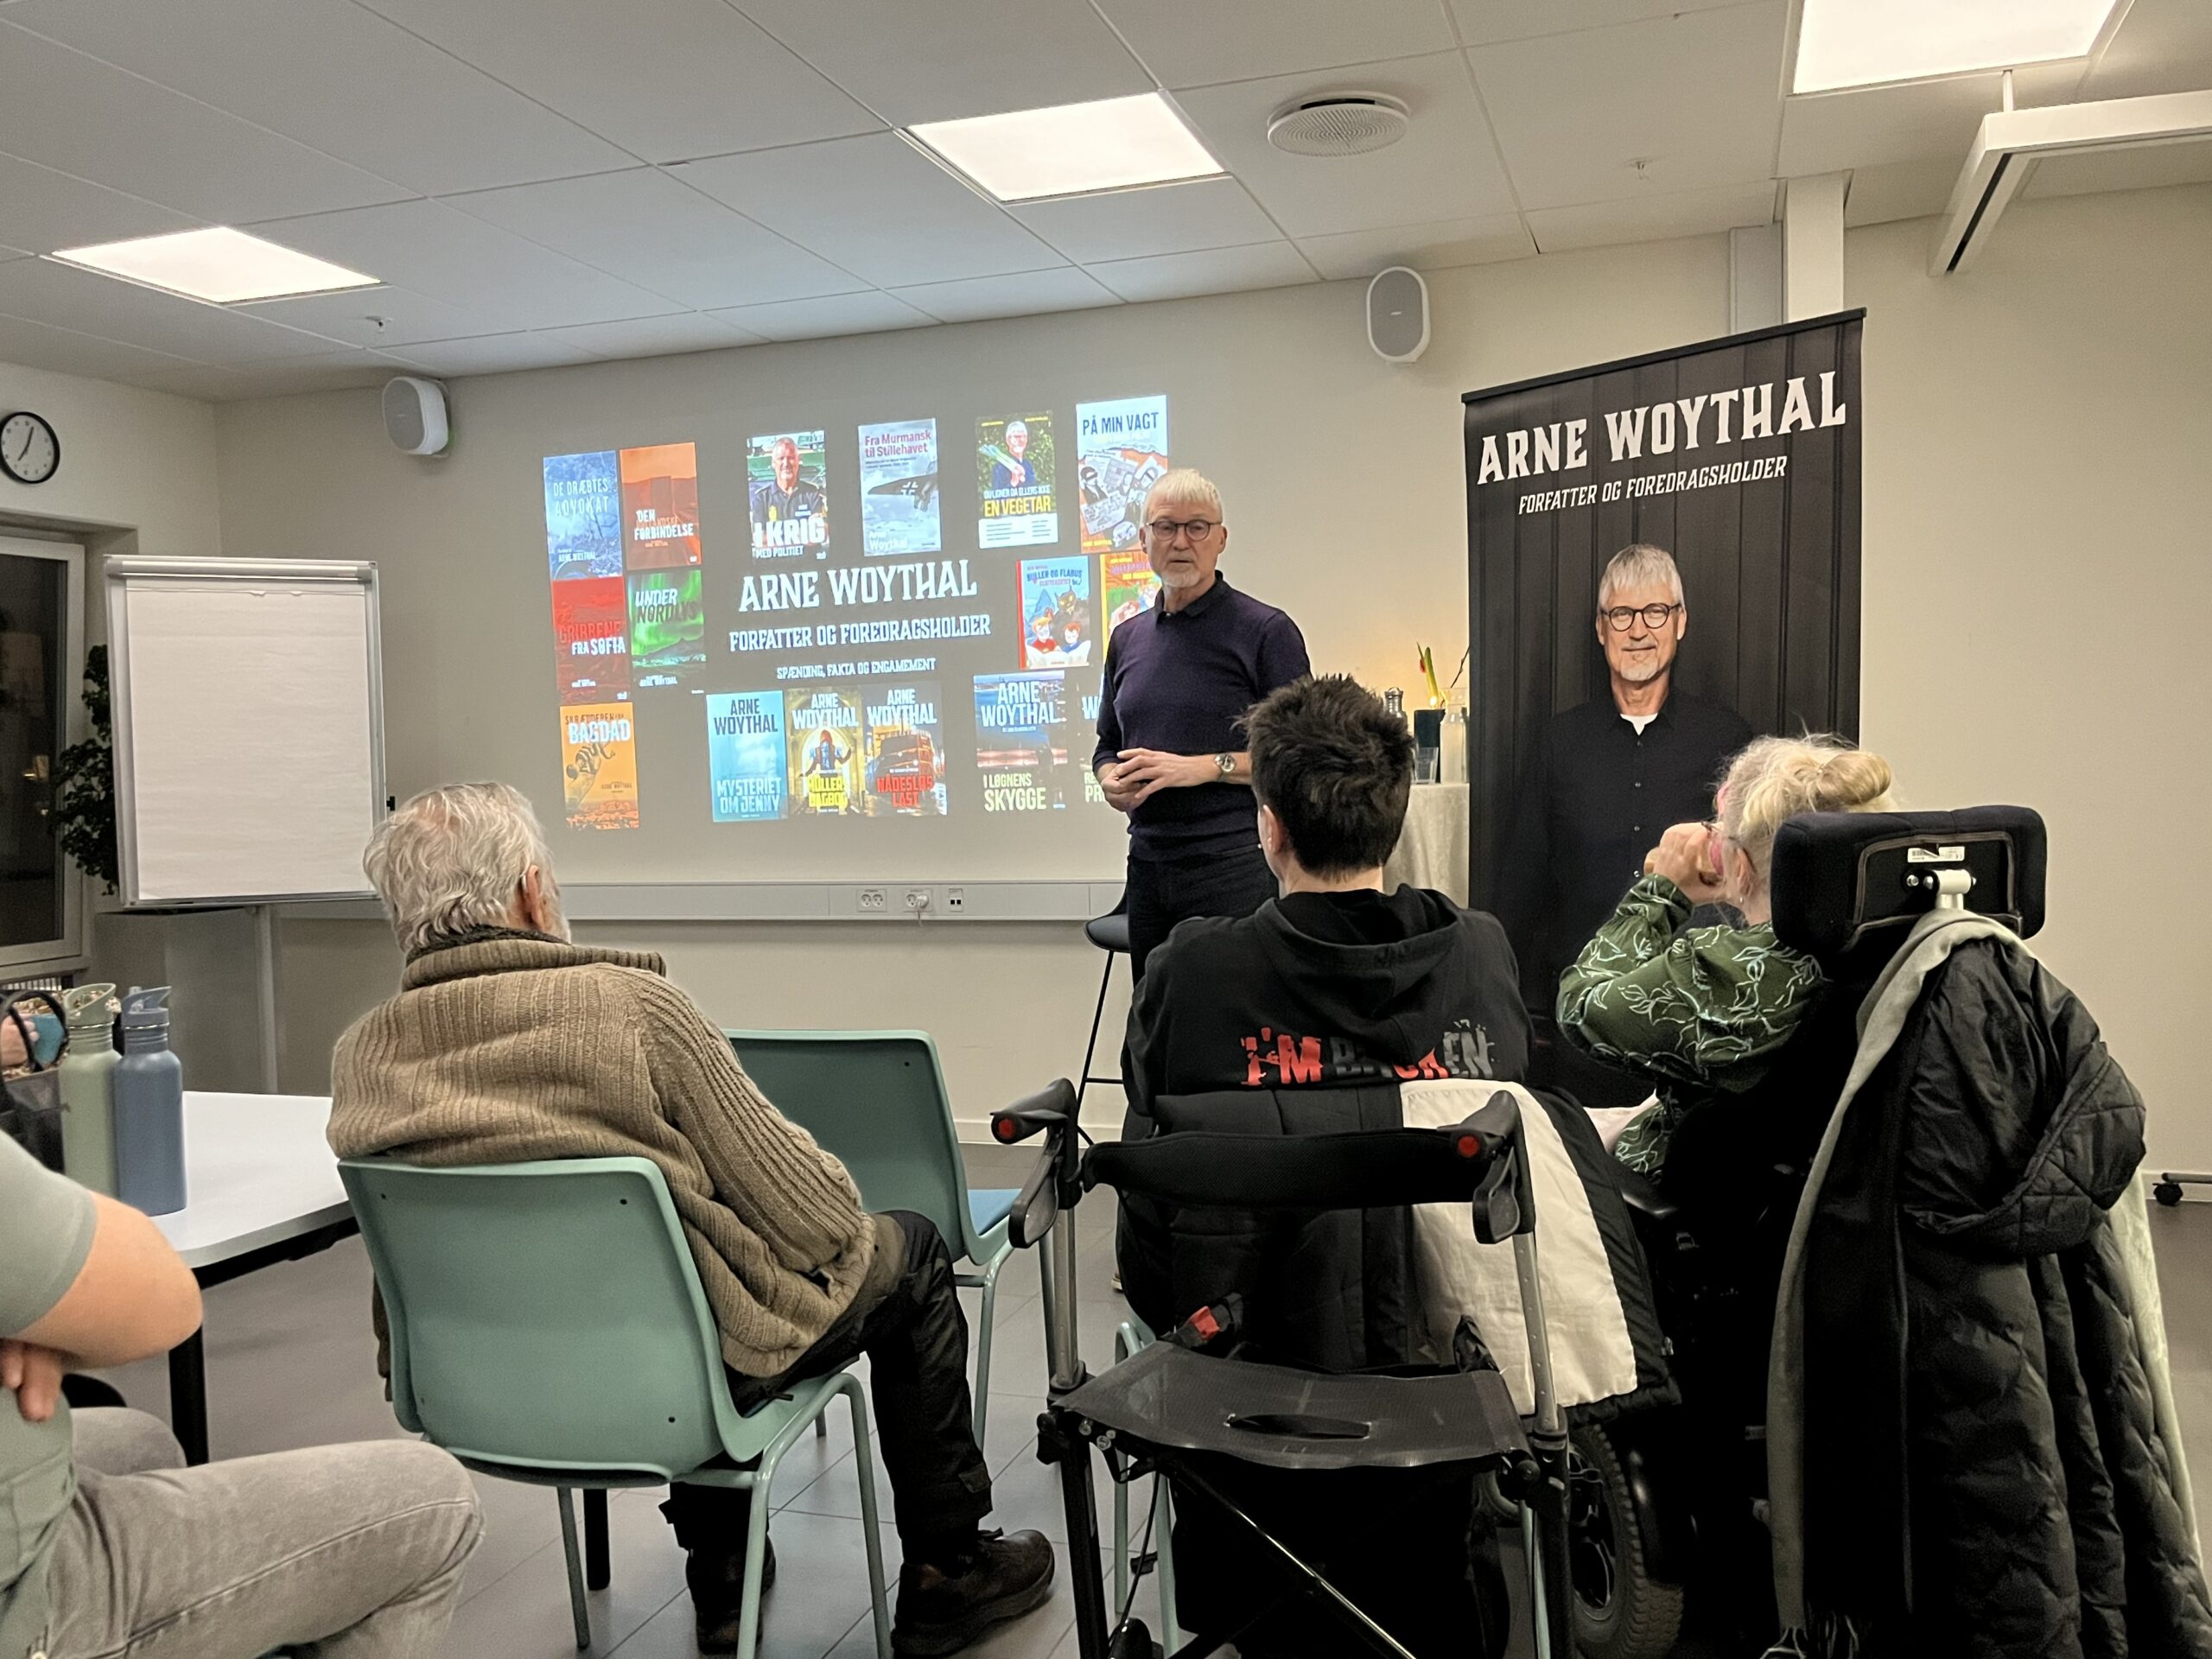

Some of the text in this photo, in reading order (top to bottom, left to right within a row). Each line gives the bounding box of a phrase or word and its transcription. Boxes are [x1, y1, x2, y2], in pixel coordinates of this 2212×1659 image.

[1083, 412, 1159, 435] PÅ MIN VAGT
[1478, 371, 1846, 485] ARNE WOYTHAL
[865, 430, 931, 447] Fra Murmansk
[866, 442, 928, 458] til Stillehavet
[553, 478, 608, 496] DE DRÆBTES
[1518, 455, 1787, 515] FORFATTER OG FOREDRAGSHOLDER
[556, 496, 608, 517] ADVOKAT
[636, 509, 656, 523] DEN
[984, 495, 1052, 517] EN VEGETAR
[634, 523, 694, 541] FORBINDELSE
[753, 517, 825, 547] I KRIG
[773, 545, 804, 557] POLITIET
[739, 559, 977, 612] ARNE WOYTHAL
[635, 588, 677, 607] UNDER
[729, 613, 992, 652] FORFATTER OG FOREDRAGSHOLDER
[572, 636, 626, 656] FRA SOFIA
[827, 662, 855, 677] FAKTA
[857, 662, 869, 675] OG
[810, 693, 839, 709] ARNE
[887, 689, 916, 706] ARNE
[997, 681, 1041, 705] ARNE
[730, 698, 760, 716] ARNE
[867, 702, 937, 727] WOYTHAL
[981, 702, 1061, 728] WOYTHAL
[714, 713, 779, 735] WOYTHAL
[791, 707, 859, 729] WOYTHAL
[569, 719, 631, 744] BAGDAD
[716, 776, 781, 798] MYSTERIET
[877, 773, 934, 792] NÅDESLØS
[983, 772, 1032, 788] I LØGNENS
[720, 795, 780, 814] OM JENNY
[892, 791, 918, 808] LAST
[984, 787, 1046, 812] SKYGGE
